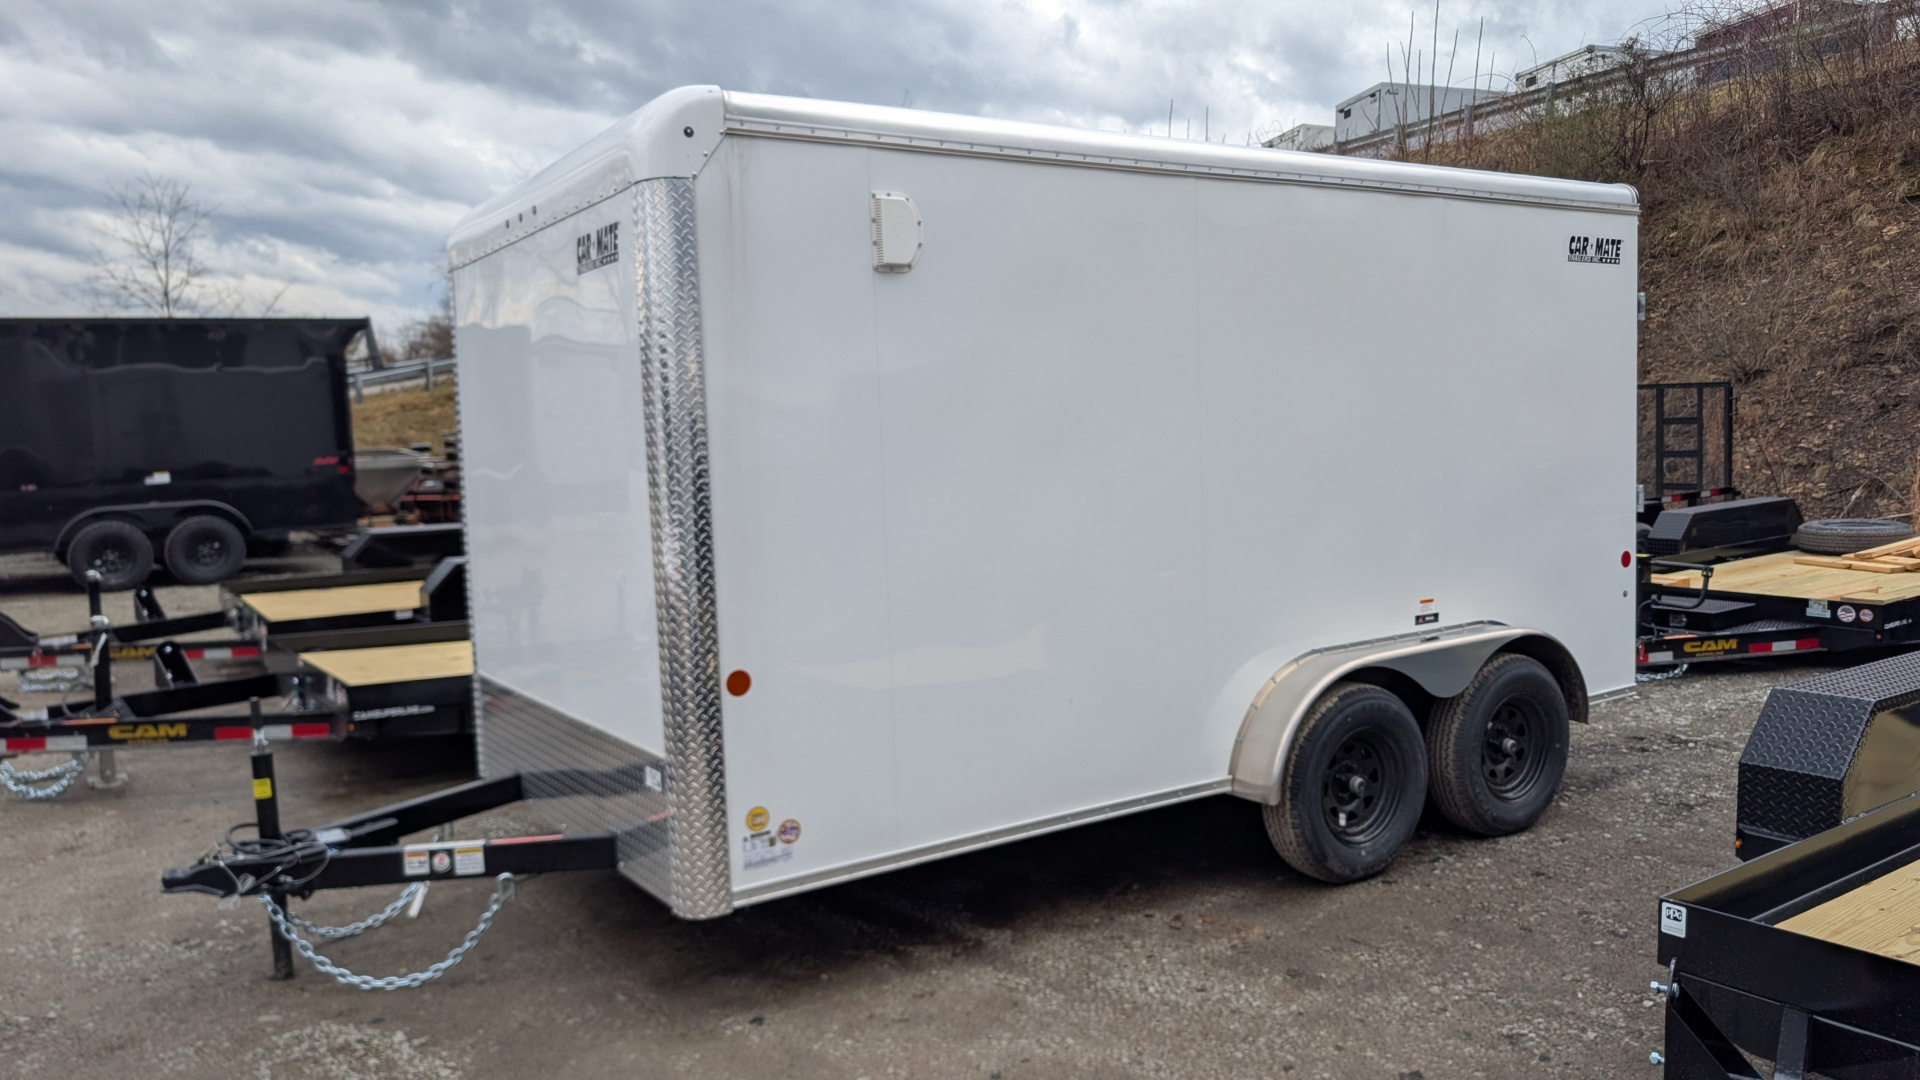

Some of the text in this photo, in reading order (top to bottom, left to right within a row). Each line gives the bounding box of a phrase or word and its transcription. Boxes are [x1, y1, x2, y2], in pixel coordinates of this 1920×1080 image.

[577, 233, 592, 264] CAR
[596, 221, 619, 258] MATE
[1569, 235, 1622, 258] CAR MATE
[1683, 639, 1738, 653] CAM
[108, 723, 188, 740] CAM
[1666, 908, 1682, 922] PPG
